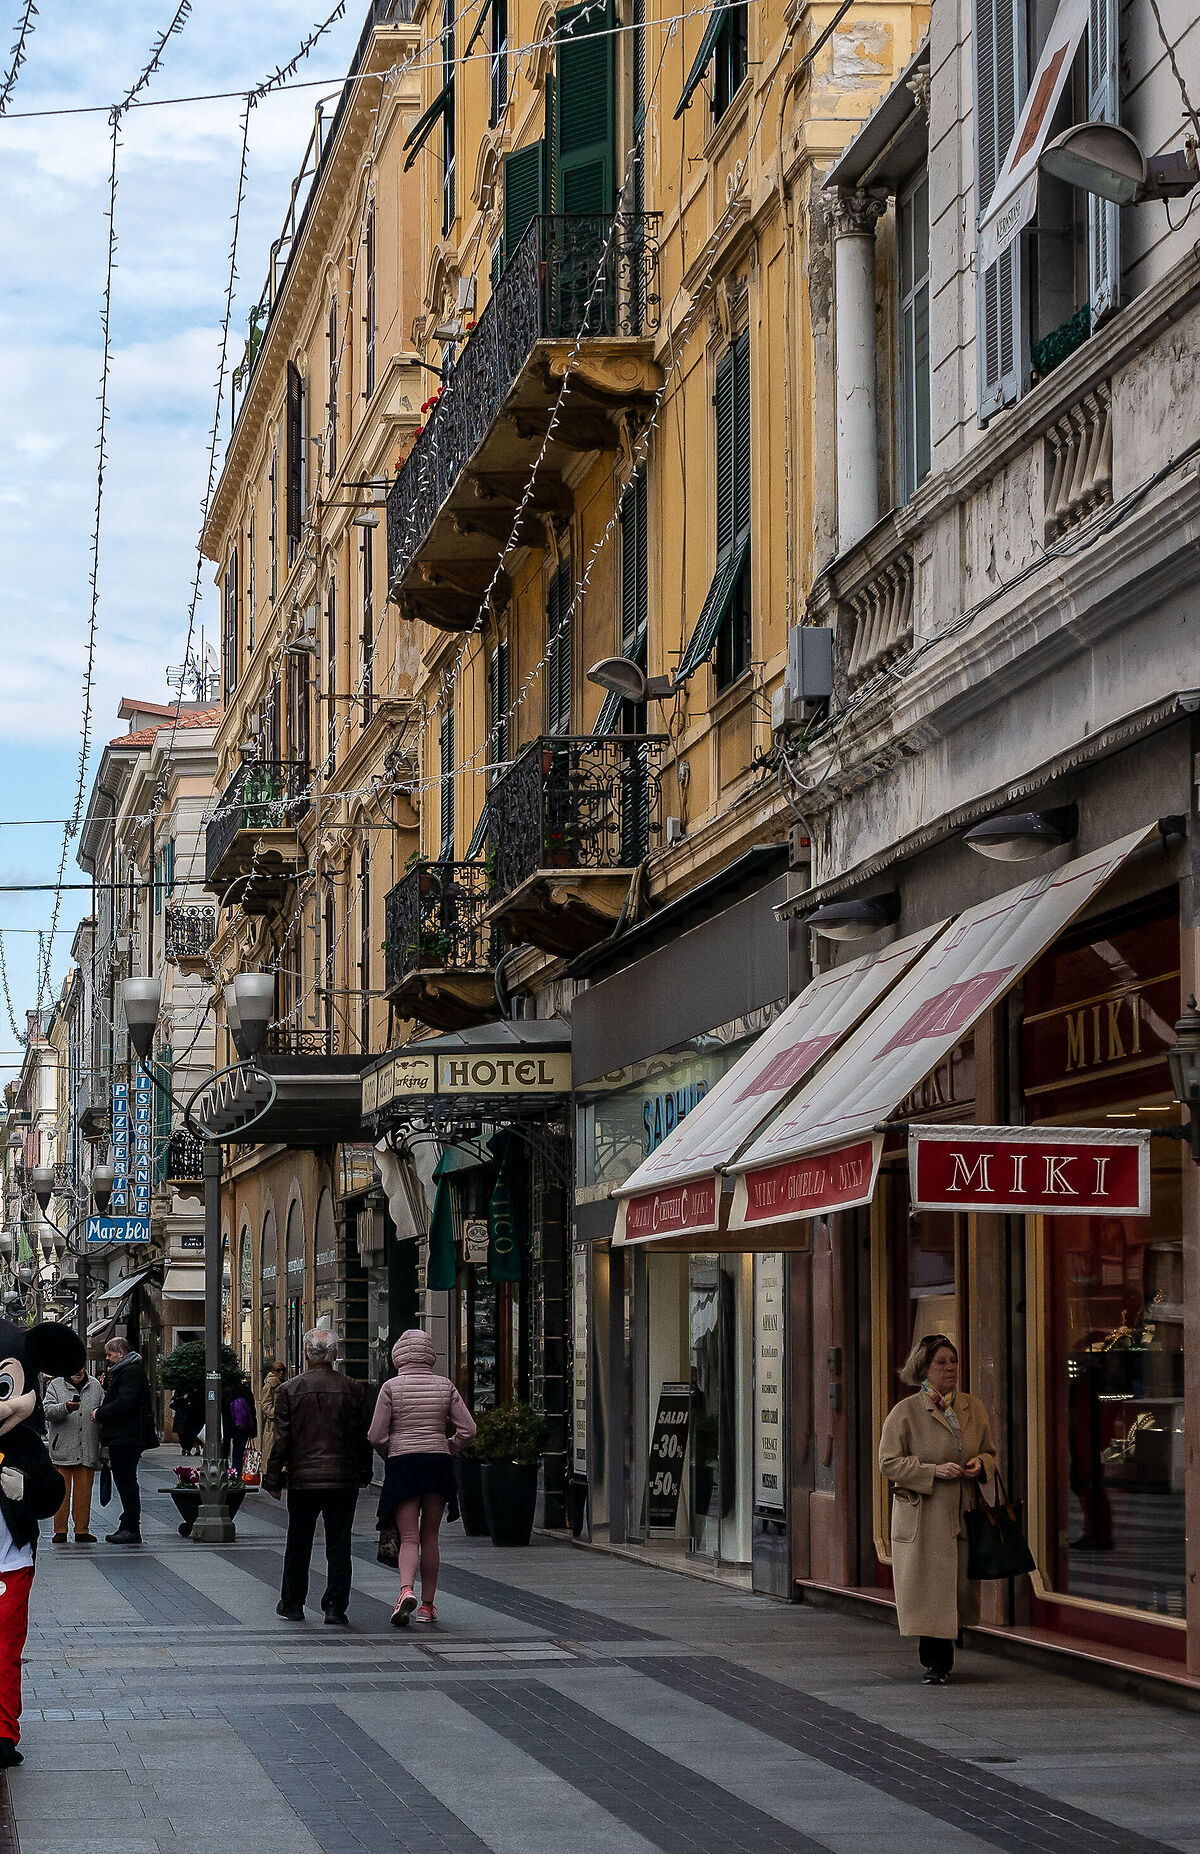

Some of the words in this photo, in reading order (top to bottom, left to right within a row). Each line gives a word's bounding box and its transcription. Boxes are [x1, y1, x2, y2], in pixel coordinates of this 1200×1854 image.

[1065, 993, 1143, 1072] MIKI
[449, 1060, 555, 1086] HOTEL
[114, 1084, 128, 1205] PIZZERIA
[754, 1179, 777, 1209] MIKI
[787, 1169, 828, 1200] GIOIELLI
[837, 1159, 864, 1191] MIKI
[945, 1153, 1111, 1195] MIKI
[87, 1220, 122, 1240] Mare
[124, 1221, 150, 1240] blu
[658, 1410, 689, 1424] SALDI
[653, 1434, 683, 1458] -30%
[649, 1471, 678, 1496] -50%
